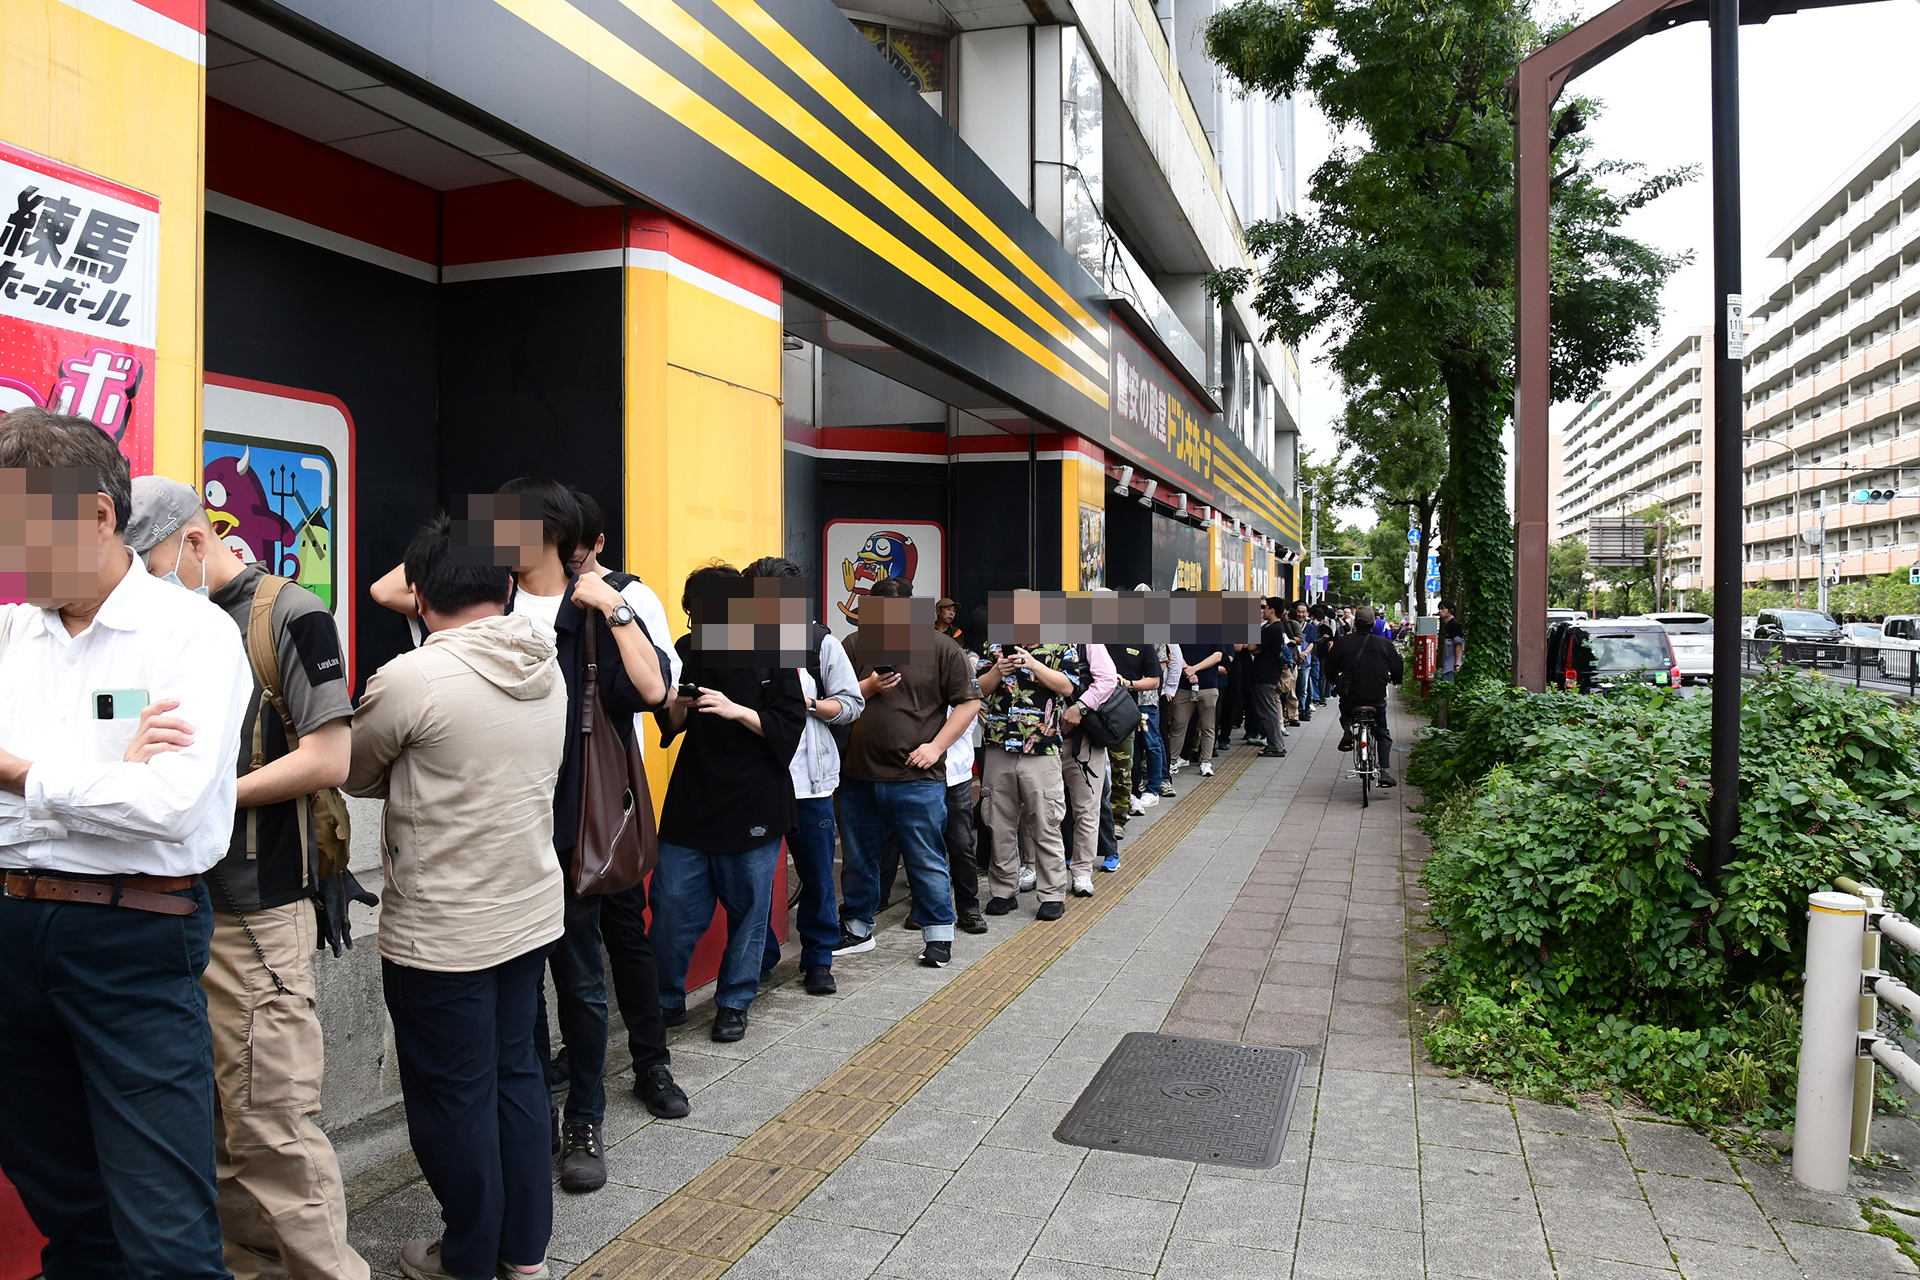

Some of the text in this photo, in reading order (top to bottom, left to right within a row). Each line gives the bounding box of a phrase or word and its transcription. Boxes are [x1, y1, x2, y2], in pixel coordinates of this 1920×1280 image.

[0, 185, 140, 284] 練馬
[1116, 352, 1167, 444] 驚安の殿堂
[316, 658, 340, 670] LayLax
